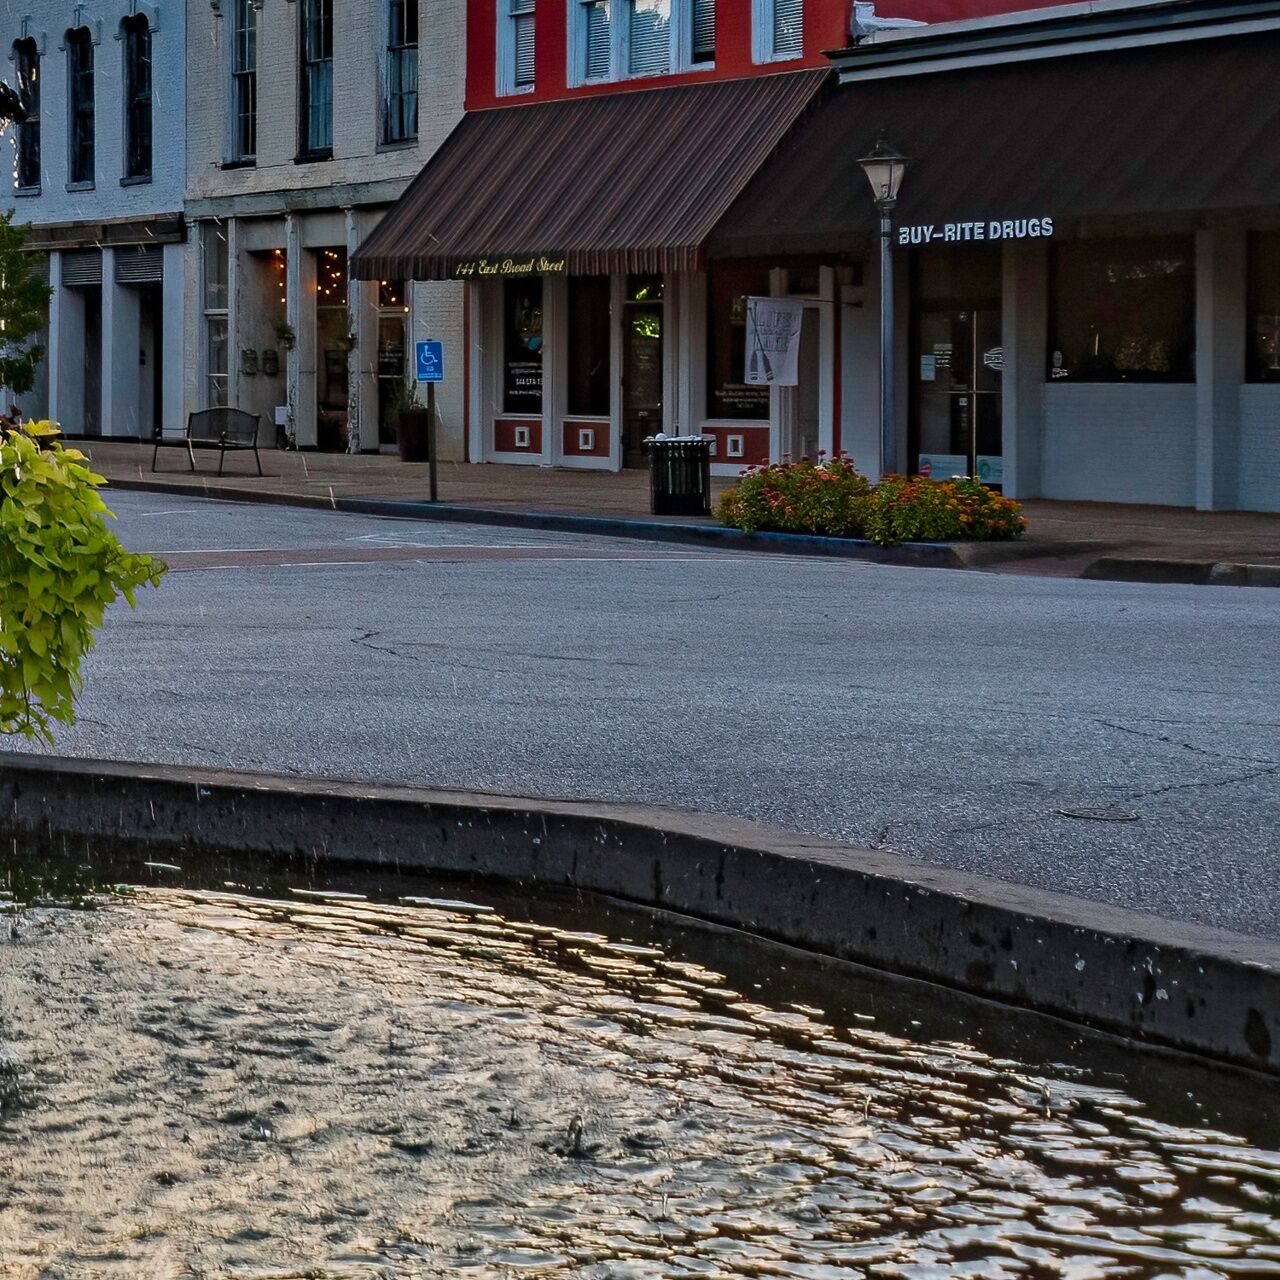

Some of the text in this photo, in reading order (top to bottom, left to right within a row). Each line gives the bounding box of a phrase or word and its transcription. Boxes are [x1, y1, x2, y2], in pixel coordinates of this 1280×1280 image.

[898, 217, 1053, 245] BUY-RITE DRUGS
[456, 257, 564, 275] 144 East Broad Street
